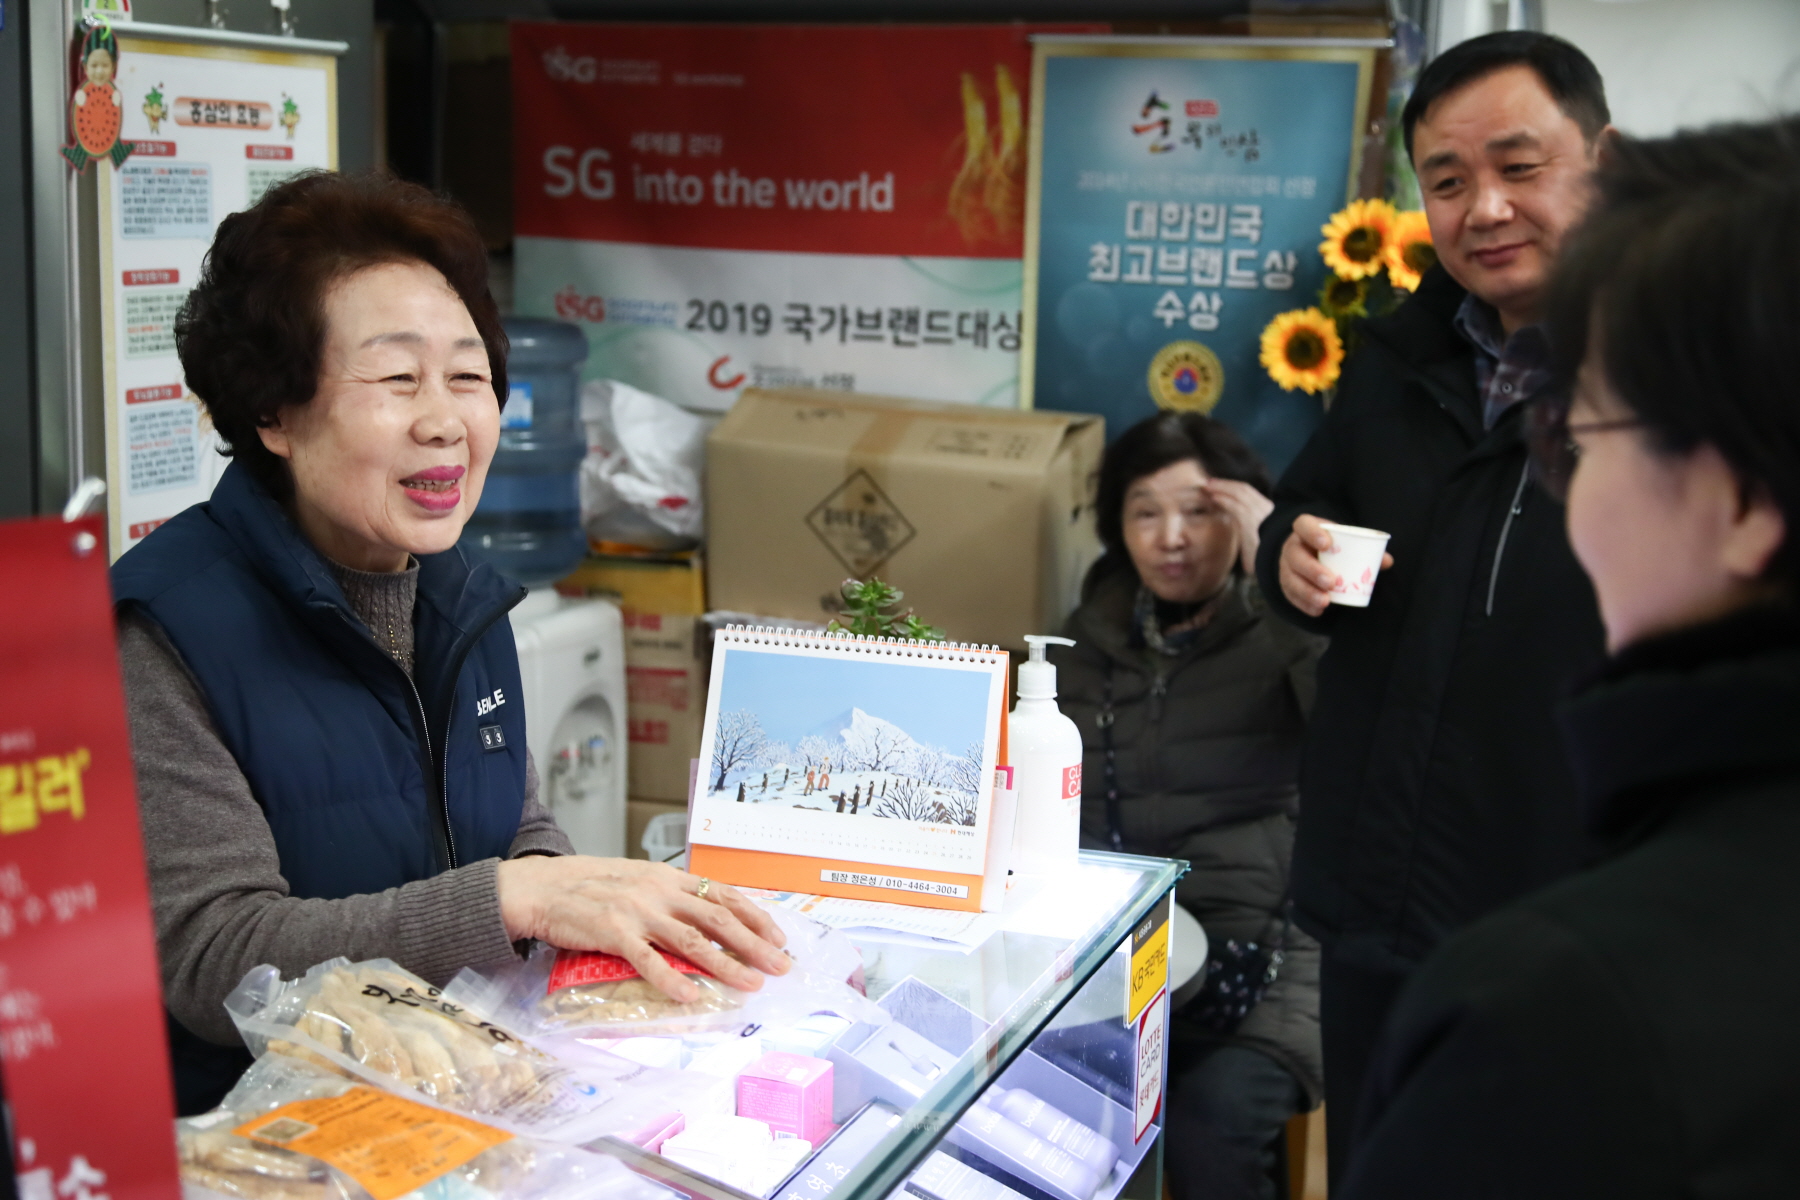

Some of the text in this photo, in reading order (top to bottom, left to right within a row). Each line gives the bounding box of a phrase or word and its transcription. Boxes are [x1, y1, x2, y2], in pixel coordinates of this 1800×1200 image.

[191, 101, 261, 126] 홍삼의 효능
[543, 146, 615, 199] SG
[632, 164, 895, 212] into the world
[1124, 200, 1263, 244] 대한민국
[1088, 241, 1298, 290] 최고브랜드상
[685, 299, 773, 335] 2019
[1153, 289, 1223, 331] 수상
[703, 818, 712, 832] 2
[831, 872, 848, 883] 팀장
[851, 874, 877, 886] 정은성
[885, 878, 958, 895] 010-4464-3004
[1132, 942, 1165, 997] KB국민카드
[1140, 1043, 1160, 1078] CARD
[1141, 1023, 1161, 1060] LOTTE
[1139, 1070, 1159, 1110] 롯데카드
